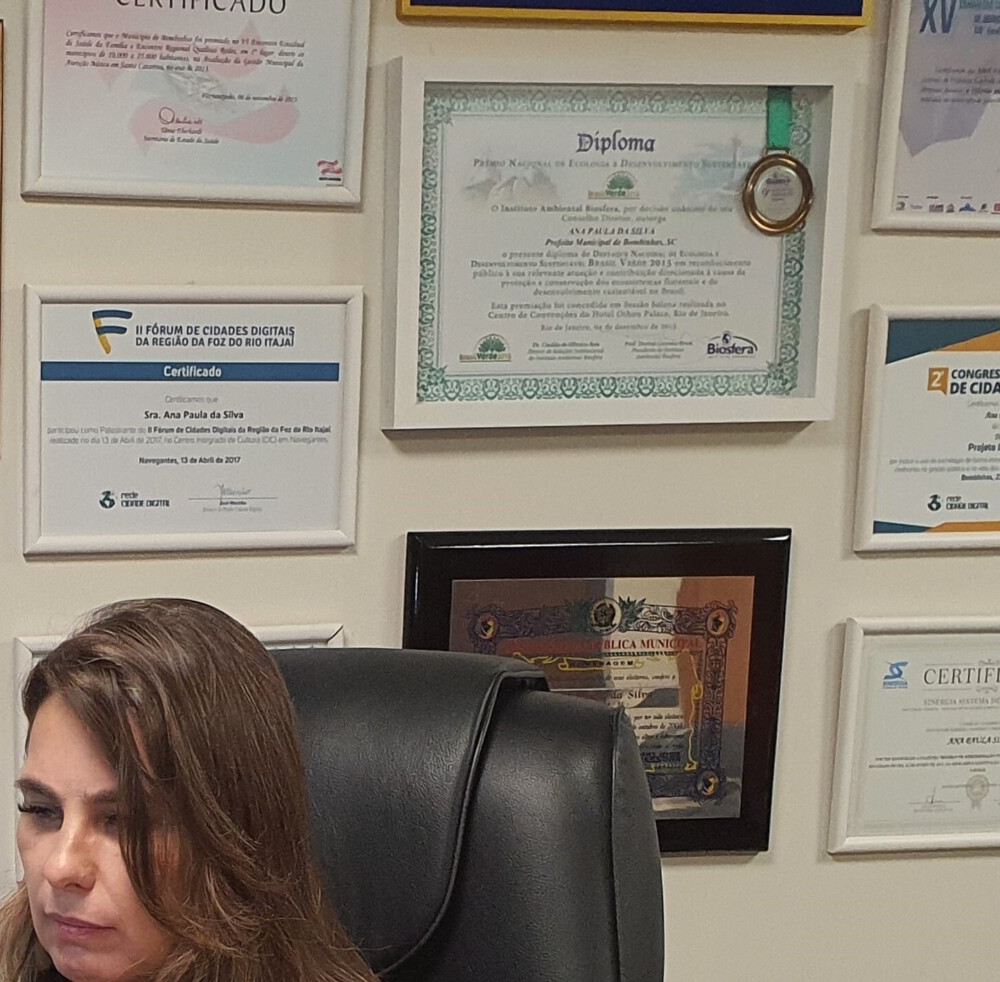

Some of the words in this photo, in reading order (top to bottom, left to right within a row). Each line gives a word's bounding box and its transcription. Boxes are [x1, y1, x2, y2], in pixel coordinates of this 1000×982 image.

[577, 130, 654, 153] Diploma
[136, 325, 142, 335] II
[146, 325, 183, 335] FÓRUM
[186, 325, 199, 335] DE
[202, 325, 248, 336] CIDADES
[250, 325, 294, 336] DIGITAIS
[135, 337, 149, 346] DA
[152, 336, 188, 346] REGIÃO
[191, 337, 204, 346] DA
[207, 337, 225, 347] FOZ
[228, 337, 242, 347] DO
[245, 337, 262, 347] RIO
[264, 337, 294, 347] ITAJAÍ
[707, 343, 754, 355] Biosfera
[164, 365, 221, 377] Certificado
[951, 368, 1000, 380] CONGRES
[950, 382, 967, 394] DE
[970, 382, 1000, 395] CIDA
[144, 411, 160, 419] Sra.
[164, 411, 181, 419] Ana
[183, 411, 207, 419] Paula
[210, 411, 221, 419] da
[223, 410, 243, 419] Silva
[180, 456, 188, 464] 13
